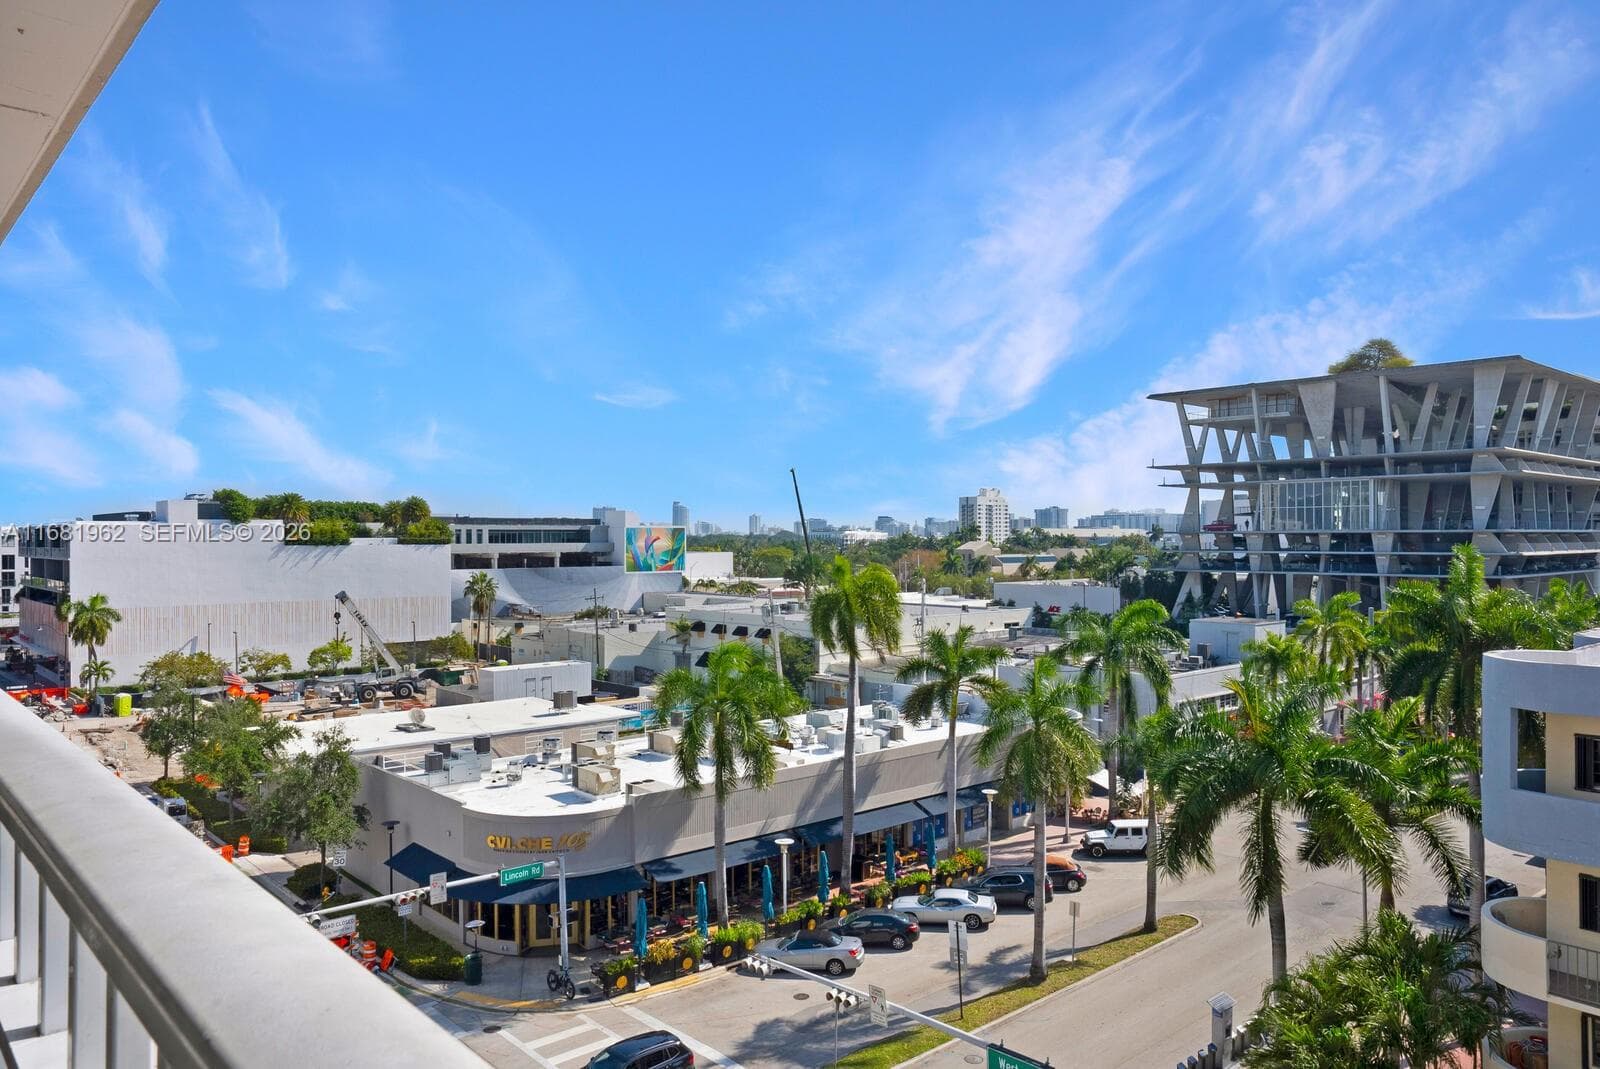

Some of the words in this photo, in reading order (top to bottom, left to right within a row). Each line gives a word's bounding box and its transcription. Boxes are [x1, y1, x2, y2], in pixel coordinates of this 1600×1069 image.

[334, 857, 345, 865] 30
[504, 869, 528, 881] Lincoln
[531, 866, 540, 875] Rd
